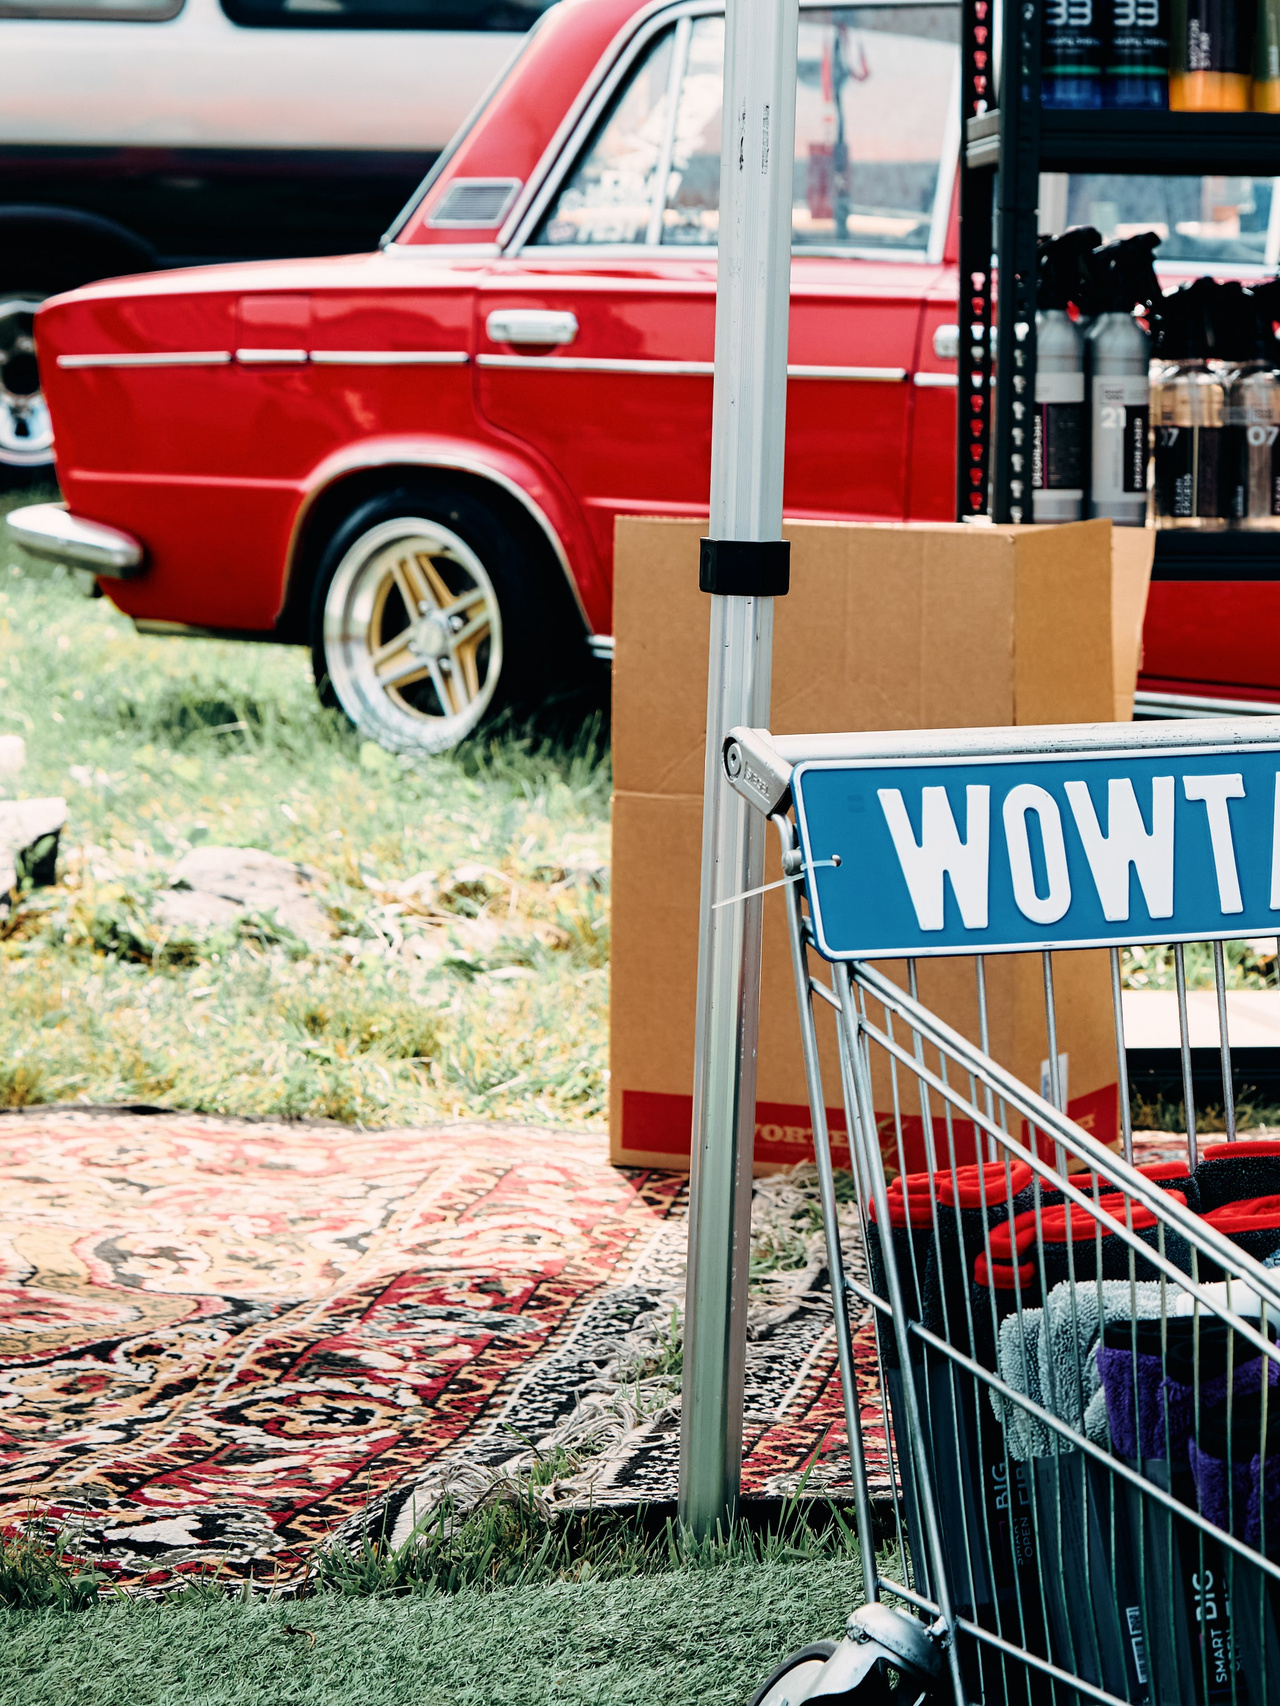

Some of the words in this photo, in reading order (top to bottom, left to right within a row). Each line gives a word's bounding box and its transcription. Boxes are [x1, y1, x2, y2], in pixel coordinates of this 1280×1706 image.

[1100, 406, 1126, 429] 21
[1248, 426, 1280, 447] 07
[991, 1462, 1008, 1510] BIG
[1021, 1516, 1033, 1558] OPEN
[1210, 1628, 1228, 1683] SMART
